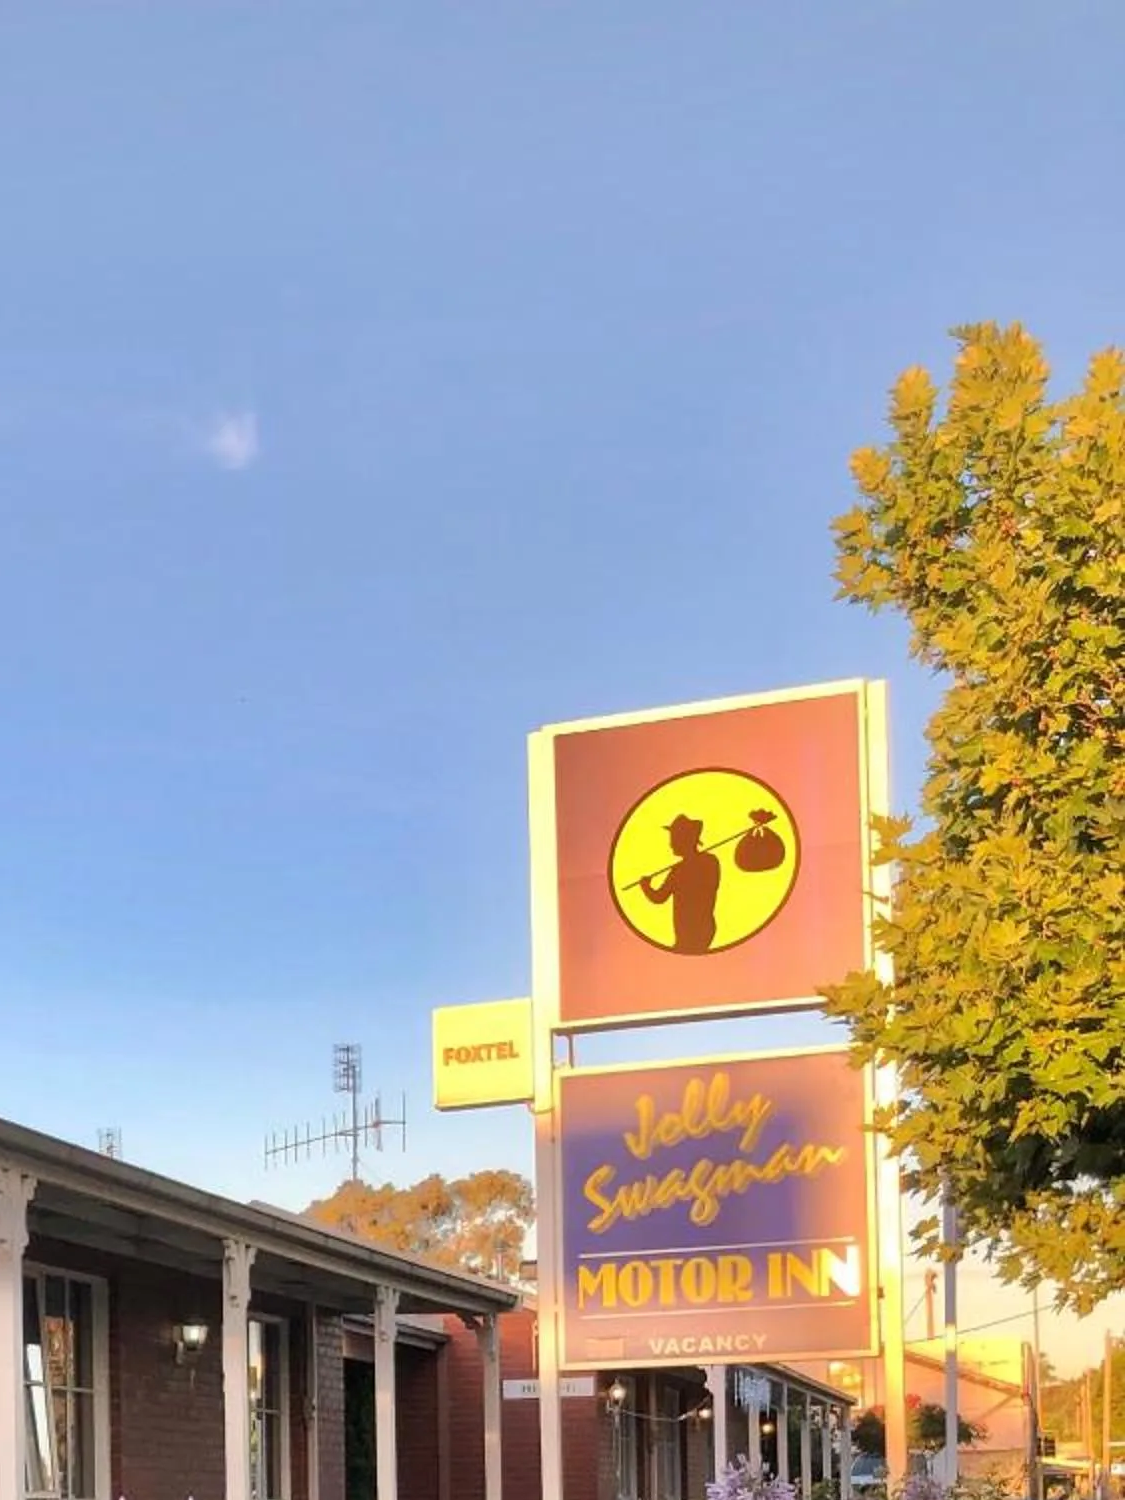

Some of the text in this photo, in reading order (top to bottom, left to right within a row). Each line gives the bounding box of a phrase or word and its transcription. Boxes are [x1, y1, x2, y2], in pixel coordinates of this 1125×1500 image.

[443, 1041, 519, 1066] FOXTEL
[625, 1073, 770, 1159] Jolly
[584, 1144, 843, 1234] Swagman
[578, 1244, 862, 1308] MOTOR INN
[649, 1334, 767, 1355] VACANCY
